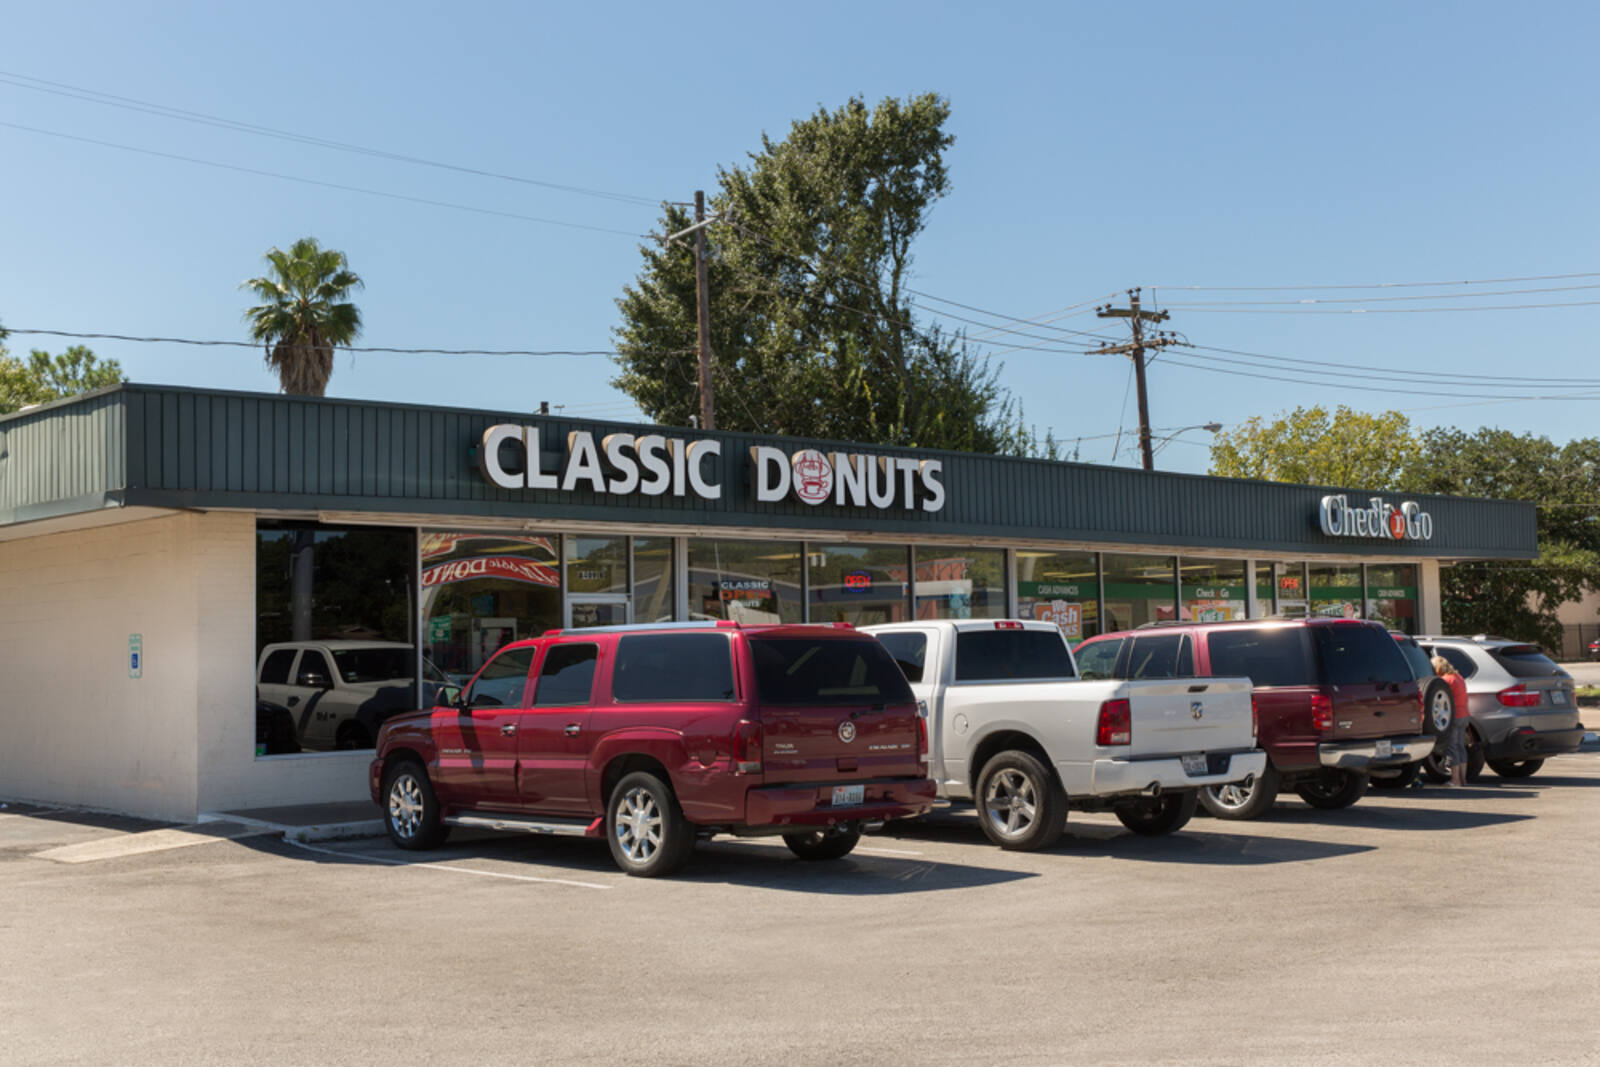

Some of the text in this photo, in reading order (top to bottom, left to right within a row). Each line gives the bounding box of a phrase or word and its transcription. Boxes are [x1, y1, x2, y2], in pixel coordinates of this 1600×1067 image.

[483, 423, 945, 512] CLASSIC DONUTS
[1320, 494, 1392, 536] Check
[1401, 501, 1433, 540] Go
[720, 581, 769, 590] CLASSIC
[720, 589, 772, 600] OPEN
[1196, 588, 1215, 598] Check
[1041, 607, 1078, 624] Cash
